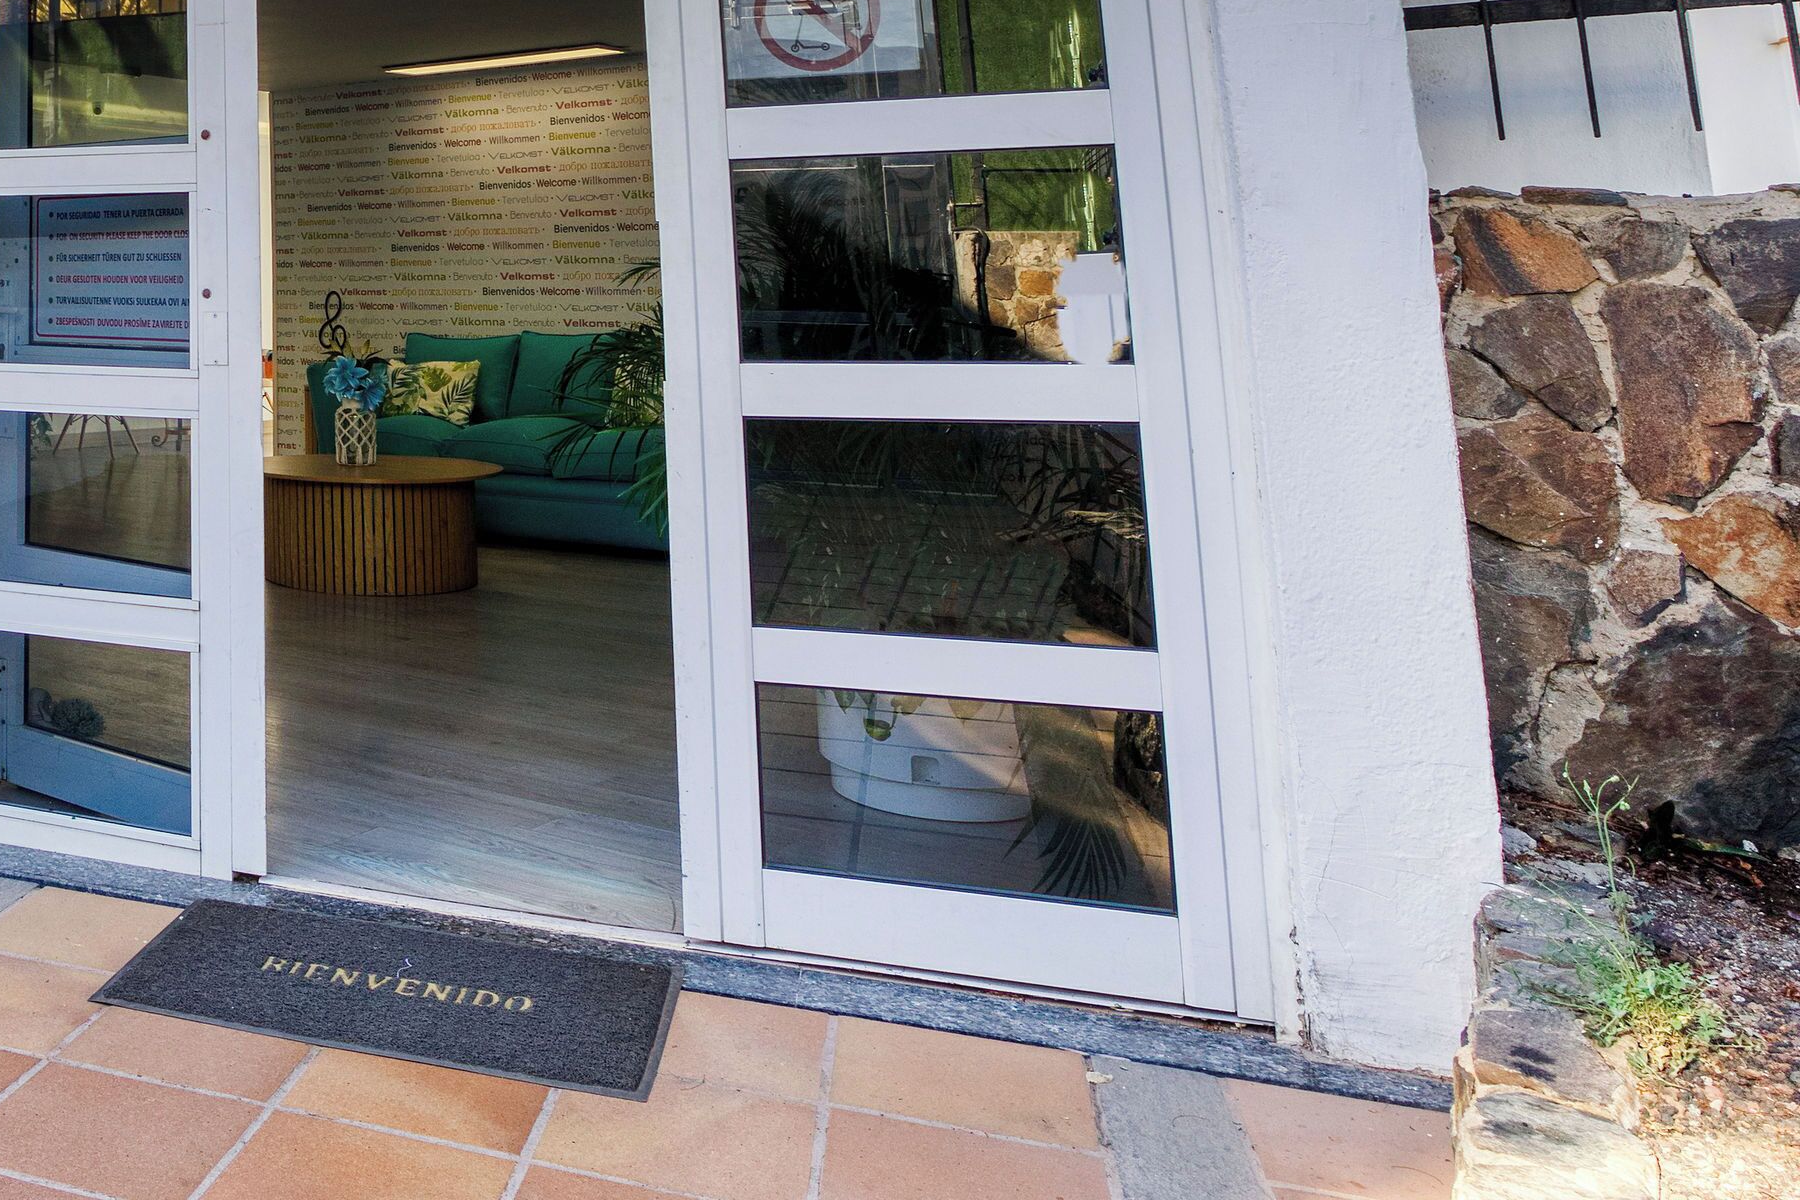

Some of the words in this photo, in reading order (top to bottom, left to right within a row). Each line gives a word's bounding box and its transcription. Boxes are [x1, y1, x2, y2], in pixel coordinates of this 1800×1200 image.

[335, 87, 382, 99] Velkomst
[475, 73, 527, 86] Bienvenidos
[531, 69, 571, 81] Welcome
[576, 63, 631, 77] Willkommen
[305, 105, 349, 116] Bienvenidos
[354, 101, 389, 111] Welcome
[395, 96, 442, 108] Willkommen
[448, 92, 491, 103] Bienvenue
[444, 106, 498, 118] Välkomna
[506, 102, 547, 114] Benvenuto
[555, 97, 612, 109] Velkomst
[299, 133, 346, 143] Välkomna
[394, 126, 444, 136] Velkomst
[549, 113, 604, 125] Bienvenidos
[388, 140, 436, 151] Bienvenidos
[444, 137, 481, 147] Welcome
[488, 133, 540, 145] Willkommen
[548, 129, 595, 141] Bienvenue
[297, 162, 330, 171] Welcome
[336, 158, 381, 168] Willkommen
[387, 155, 429, 165] Bienvenue
[551, 144, 610, 156] Välkomna
[391, 169, 443, 179] Välkomna
[497, 164, 551, 174] Velkomst
[338, 187, 385, 196] Velkomst
[479, 179, 531, 190] Bienvenidos
[535, 177, 576, 187] Welcome
[581, 174, 636, 185] Willkommen
[307, 202, 351, 211] Bienvenidos
[357, 201, 392, 209] Welcome
[398, 198, 445, 208] Willkommen
[451, 196, 495, 205] Bienvenue
[56, 211, 68, 220] POR
[68, 211, 100, 220] SEGURIDAD
[103, 210, 122, 219] TENER
[122, 209, 131, 218] LA
[131, 208, 155, 218] PUERTA
[155, 208, 184, 217] CERRADA
[298, 217, 335, 226] Bienvenue
[447, 211, 502, 221] Välkomna
[559, 207, 617, 217] Velkomst
[69, 232, 78, 240] ON
[79, 232, 105, 241] SECURITY
[105, 231, 128, 240] PLEASE
[127, 231, 141, 239] KEEP
[141, 230, 154, 239] THE
[154, 230, 173, 239] DOOR
[300, 231, 348, 240] Välkomna
[397, 228, 447, 237] Velkomst
[553, 223, 609, 233] Bienvenidos
[616, 221, 658, 231] Welcome
[391, 242, 439, 252] Bienvenidos
[447, 241, 484, 250] Welcome
[492, 240, 543, 250] Willkommen
[552, 239, 599, 248] Bienvenue
[56, 252, 67, 262] FÜR
[68, 253, 100, 262] SICHERHEIT
[101, 252, 120, 262] TÜREN
[122, 253, 135, 262] GUT
[136, 253, 145, 262] ZU
[145, 252, 182, 262] SCHLIESSEN
[299, 259, 332, 267] Welcome
[338, 259, 383, 267] Willkommen
[390, 258, 431, 266] Bienvenue
[554, 254, 614, 264] Välkomna
[55, 275, 72, 284] DEUR
[72, 275, 101, 284] GESLOTEN
[102, 275, 129, 284] HOUDEN
[130, 275, 148, 284] VOOR
[149, 275, 184, 284] VEILIGHEID
[393, 272, 446, 280] Välkomna
[499, 272, 554, 280] Velkomst
[482, 286, 535, 295] Bienvenidos
[539, 286, 580, 295] Welcome
[585, 286, 641, 295] Willkommen
[136, 297, 167, 306] SULKEKAA
[168, 298, 179, 307] OVI
[358, 302, 393, 310] Welcome
[399, 302, 447, 310] Willkommen
[455, 302, 498, 310] Bienvenue
[450, 317, 505, 326] Välkomna
[562, 319, 620, 327] Velkomst
